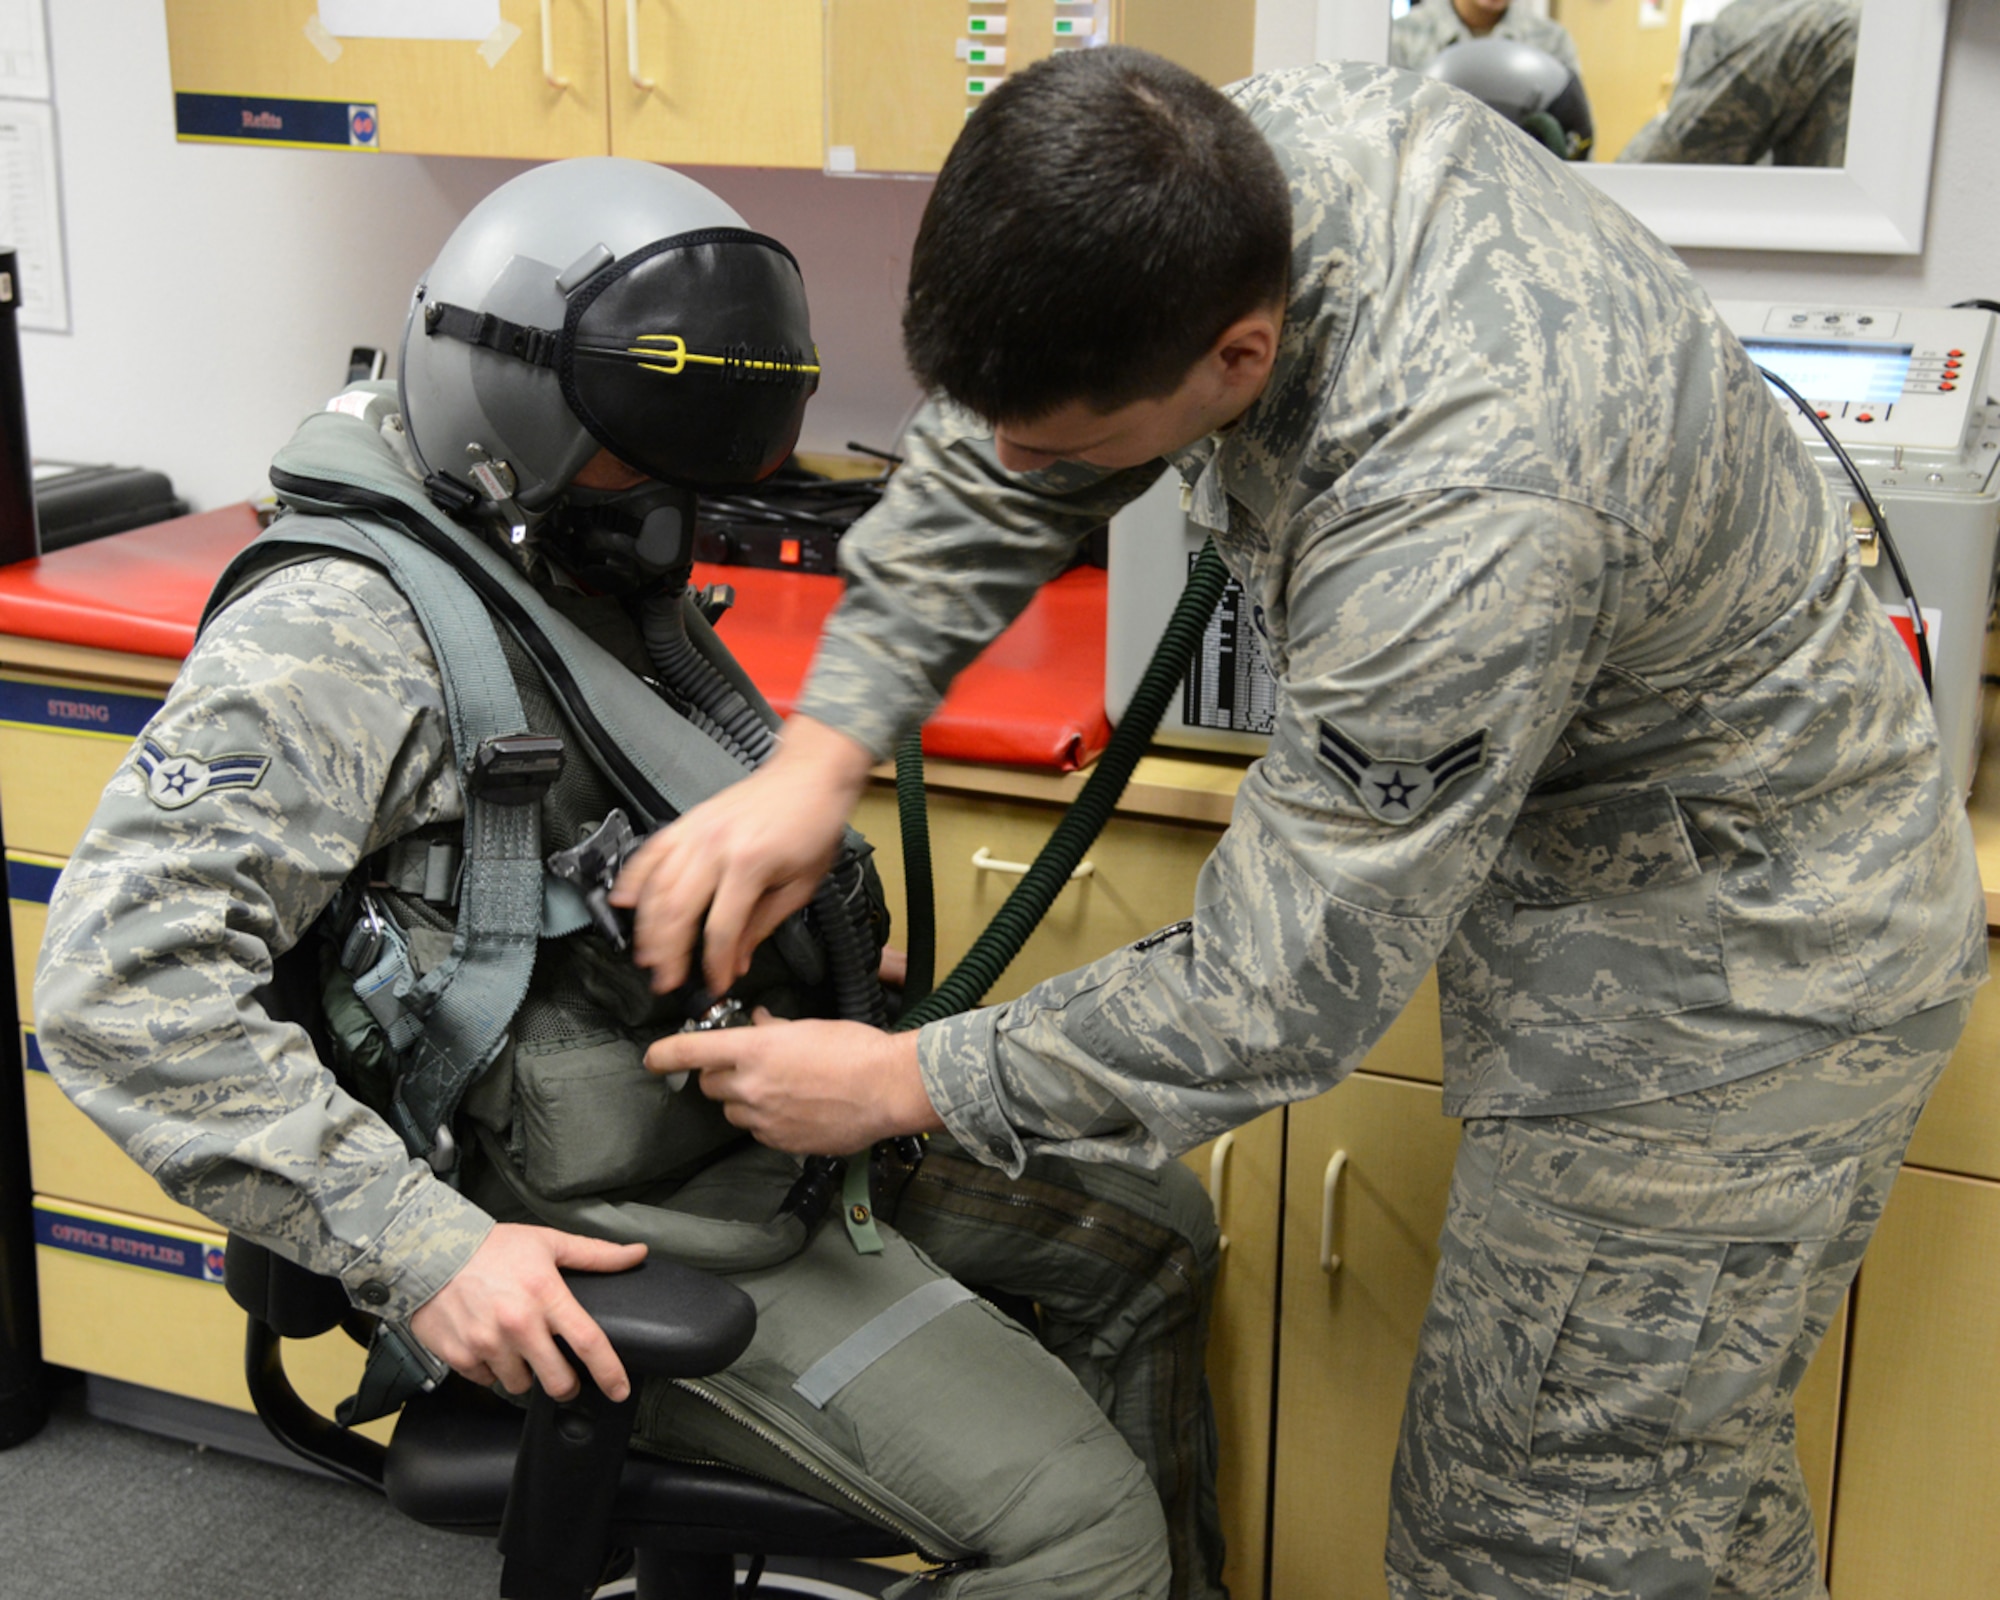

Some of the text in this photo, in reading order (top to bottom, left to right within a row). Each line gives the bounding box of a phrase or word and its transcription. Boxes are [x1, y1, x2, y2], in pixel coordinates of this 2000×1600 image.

[47, 699, 110, 723] STRING
[51, 1223, 186, 1267] OFFICE SUPPLIES
